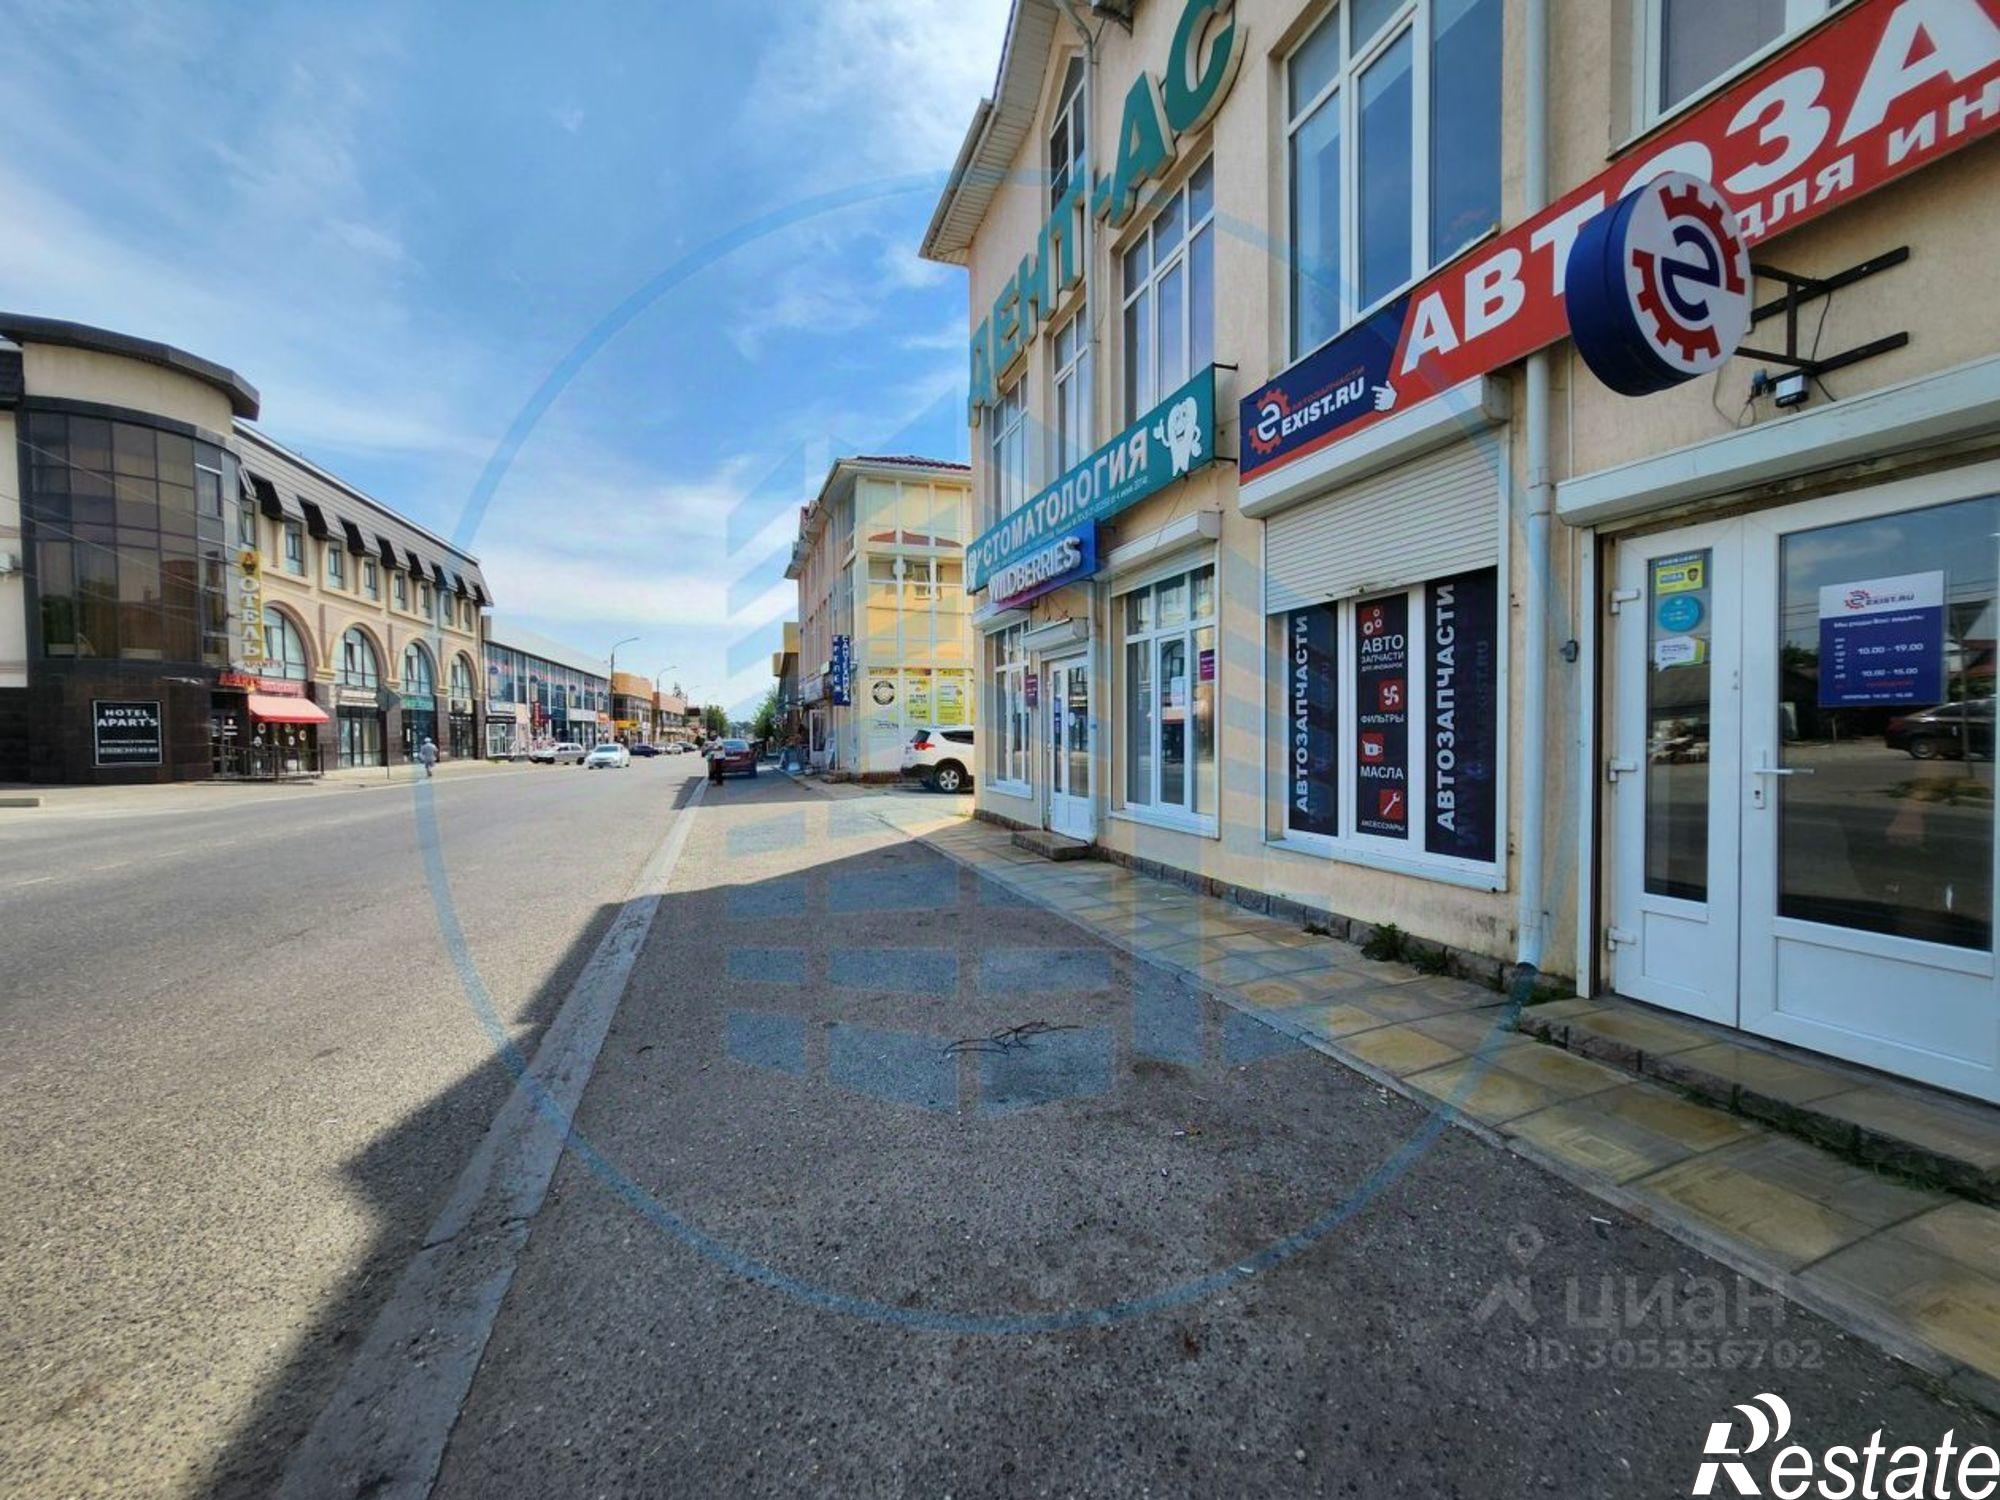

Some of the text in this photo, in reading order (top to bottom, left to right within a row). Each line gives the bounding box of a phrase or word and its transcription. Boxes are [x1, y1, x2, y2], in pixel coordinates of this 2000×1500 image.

[1734, 153, 1855, 239] для
[1281, 376, 1364, 437] EXIST.RU
[983, 426, 1148, 567] СТОМАТОЛОГИЯ
[988, 535, 1082, 602] WILDBERRIES
[240, 577, 261, 656] ОТЕЛЬ
[1361, 634, 1404, 654] АВТО
[1361, 651, 1404, 665] ЗАПЧАСТИ
[98, 716, 159, 727] APART'S
[105, 708, 149, 717] HOTEL
[1295, 615, 1309, 814] АВТОЗАПЧАСТИ
[1360, 713, 1405, 724] ФИЛЬТРЫ
[1436, 584, 1455, 832] АВТОЗАПЧАСТИ
[1360, 766, 1404, 780] МАСЛА
